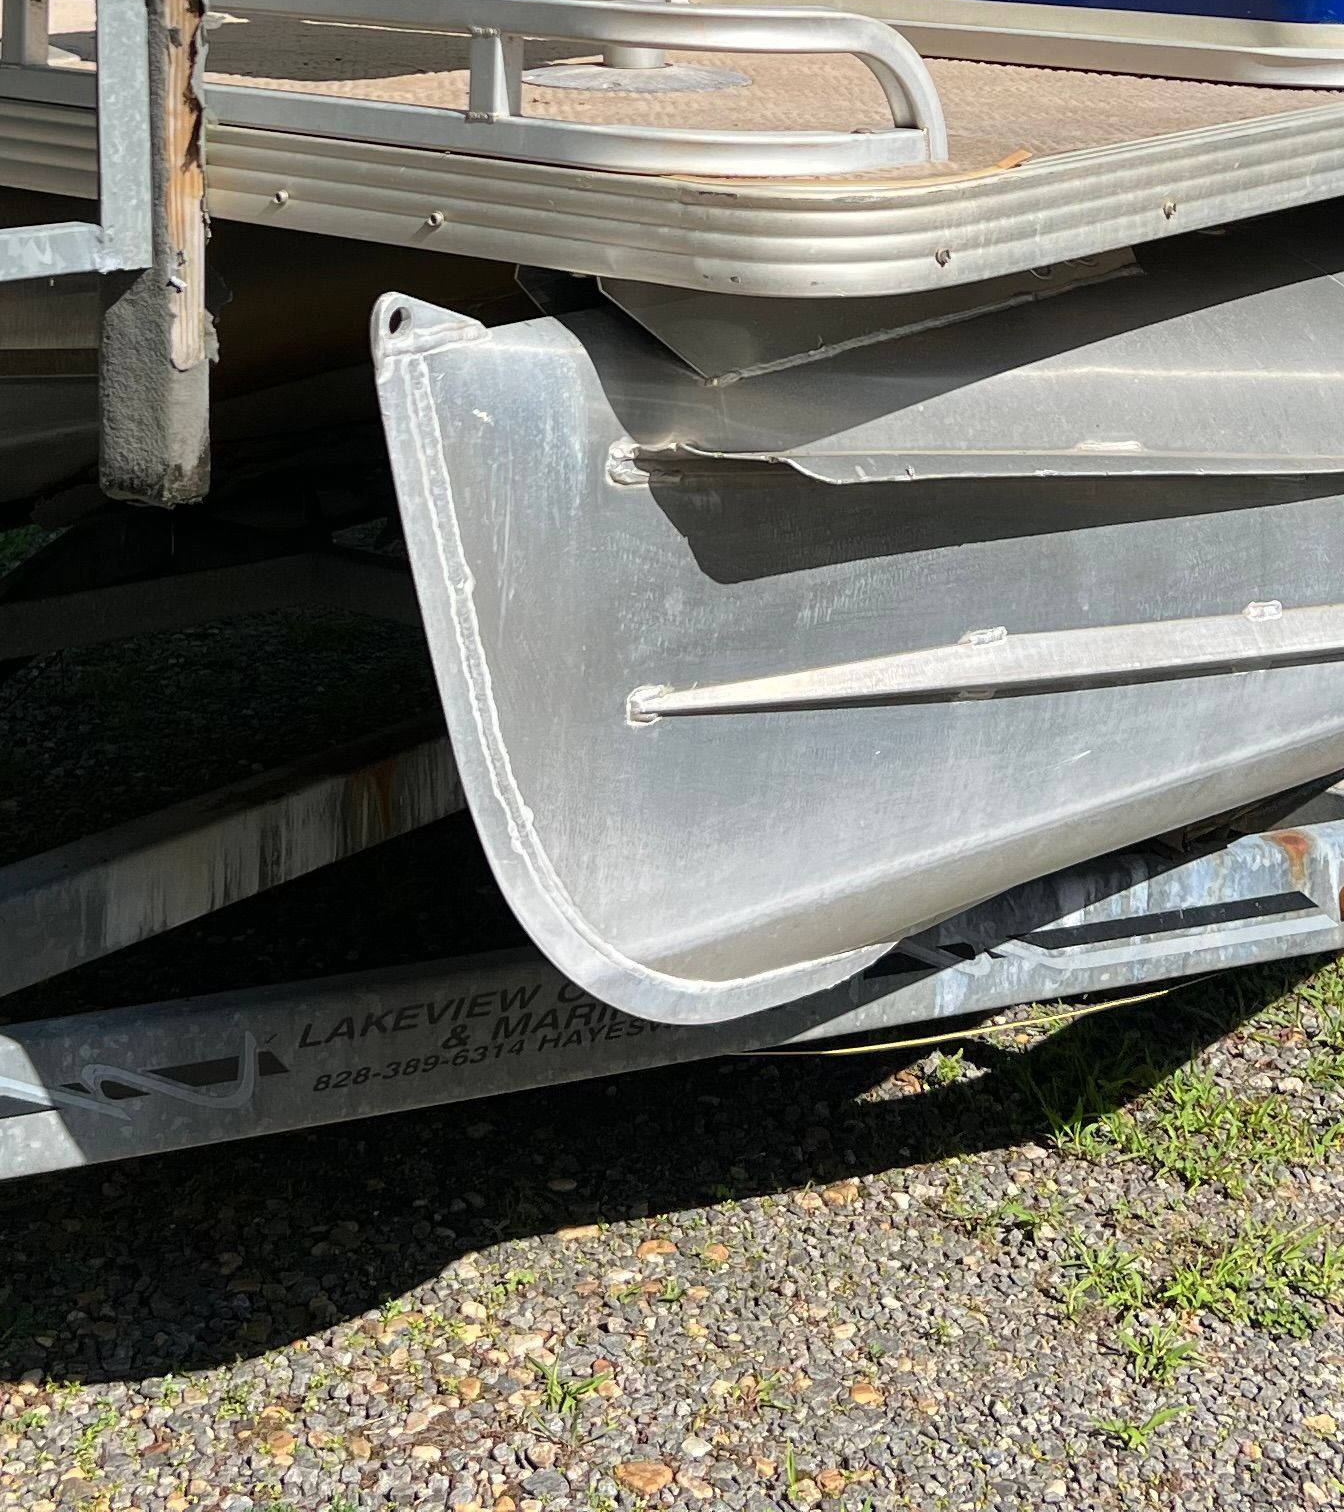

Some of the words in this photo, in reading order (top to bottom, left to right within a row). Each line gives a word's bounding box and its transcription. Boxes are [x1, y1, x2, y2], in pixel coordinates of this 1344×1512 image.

[297, 982, 543, 1050] LAKEVIEW
[441, 1023, 470, 1049] &
[312, 1038, 525, 1092] 828-389-6314
